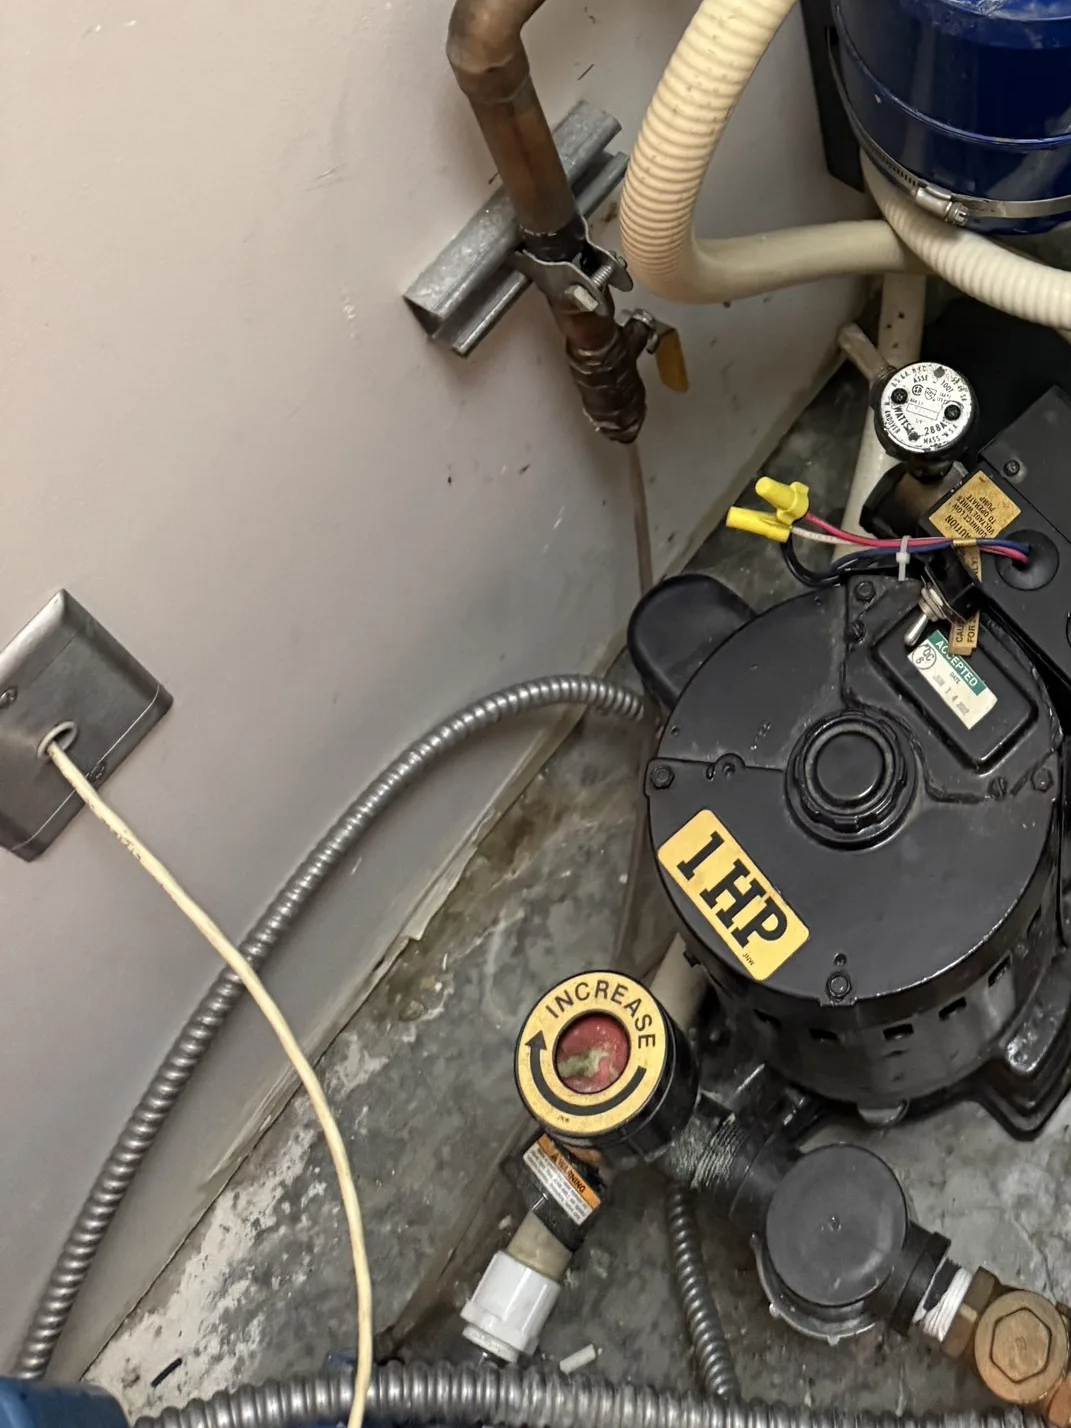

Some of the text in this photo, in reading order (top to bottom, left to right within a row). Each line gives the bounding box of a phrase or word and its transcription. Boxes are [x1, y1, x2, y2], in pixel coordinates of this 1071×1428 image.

[884, 410, 901, 434] ANDOVER
[956, 496, 995, 535] VOLTAGE WIRES
[966, 494, 990, 517] OPERATE
[979, 496, 996, 511] PUMP
[945, 515, 971, 539] AUTION
[952, 503, 987, 538] CONNECT LOW
[987, 515, 996, 524] TO
[967, 625, 975, 642] FOR
[950, 672, 961, 684] DATE
[676, 830, 789, 950] 1 HP
[545, 978, 657, 1050] INCREASE
[556, 1158, 587, 1194] WARNING
